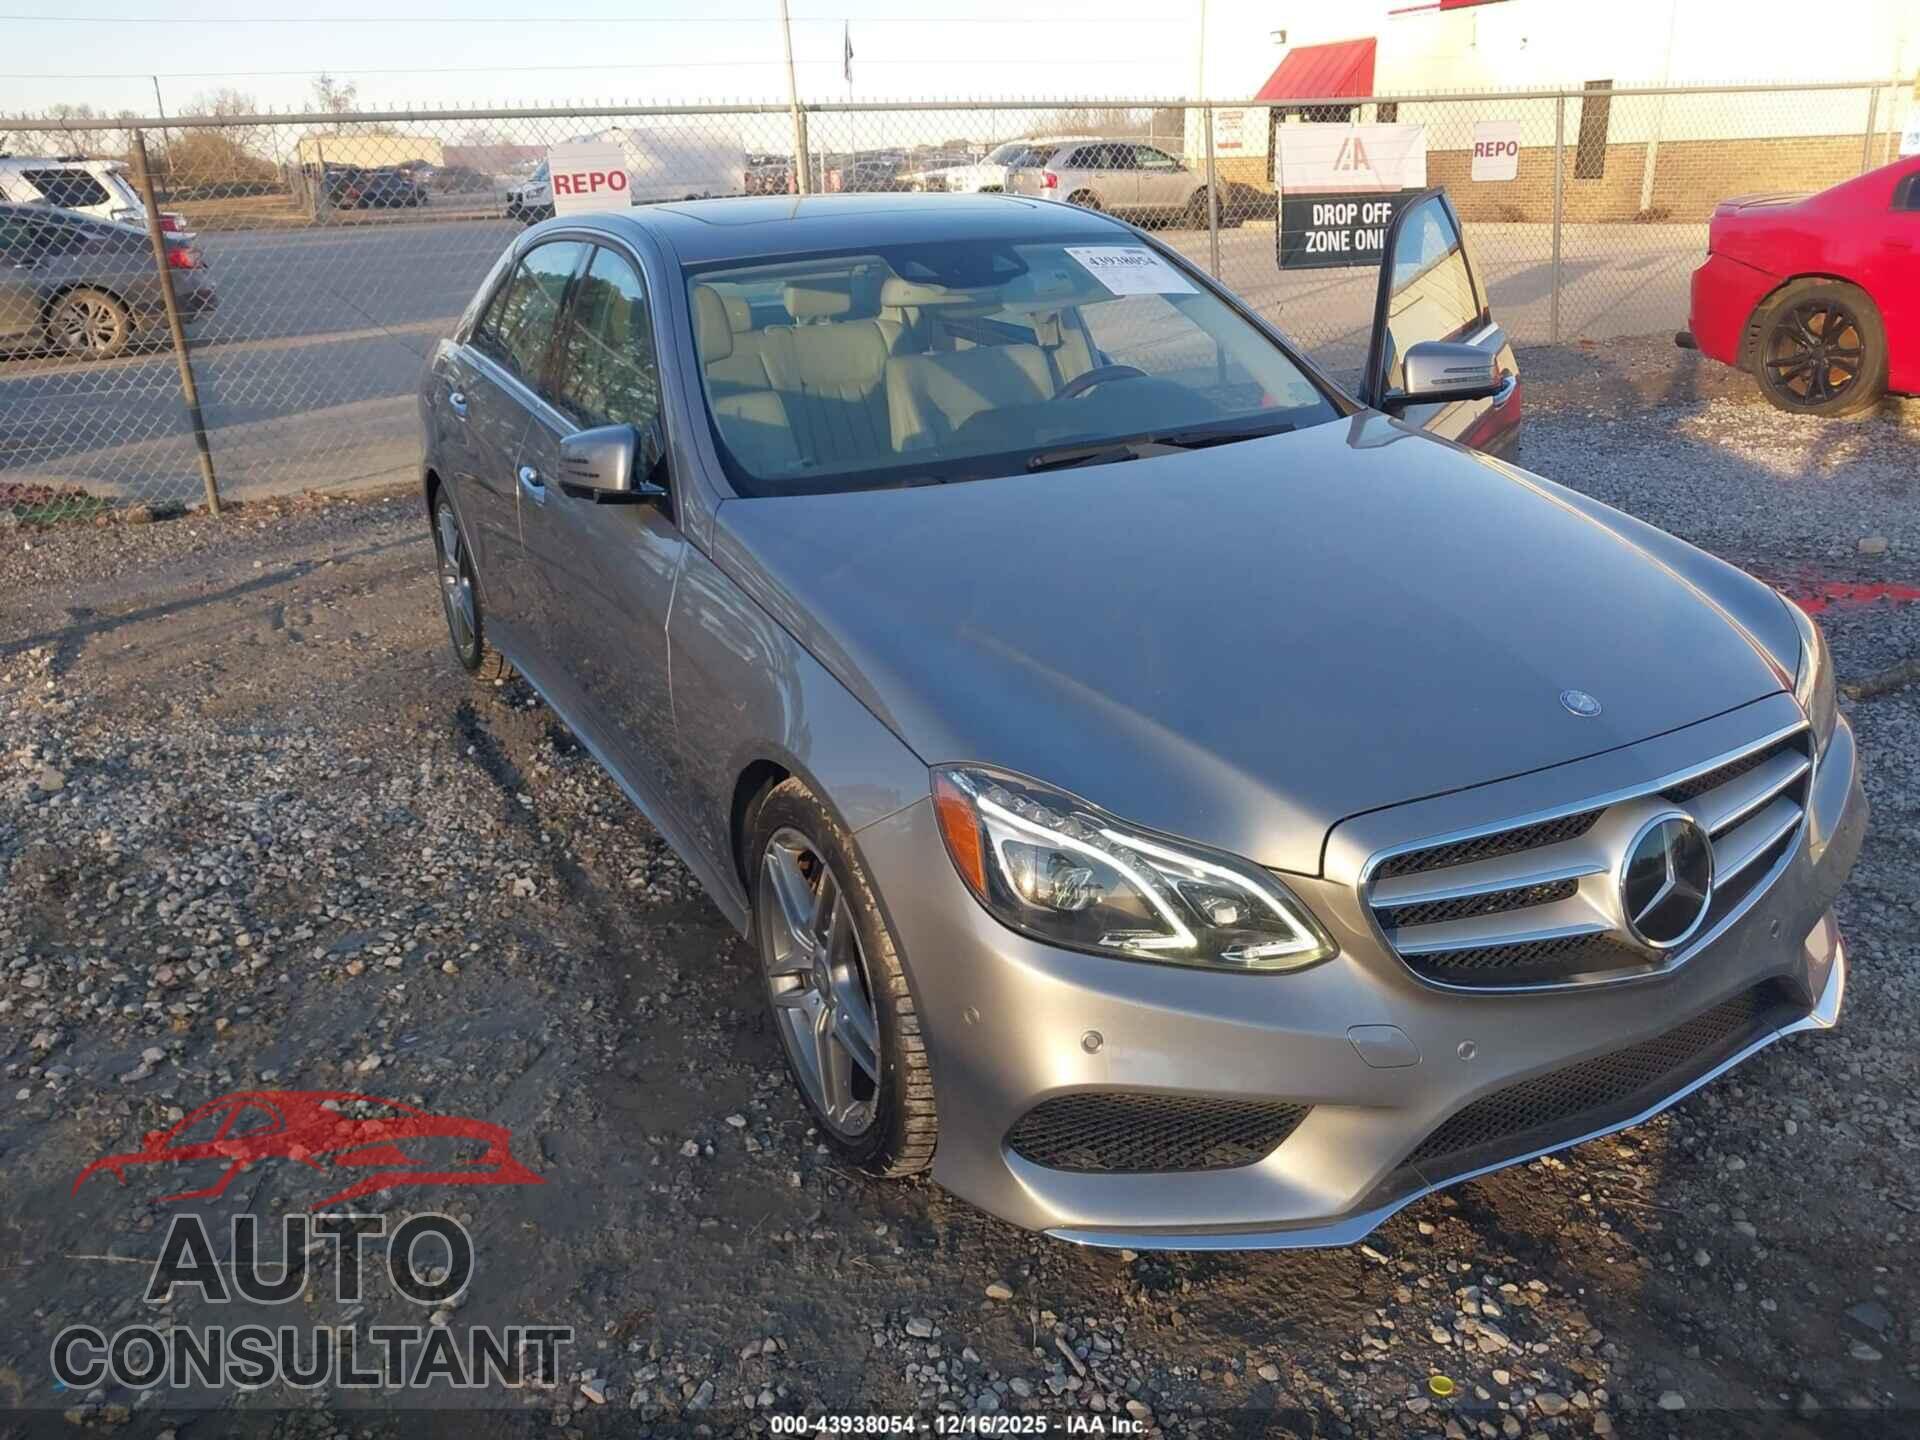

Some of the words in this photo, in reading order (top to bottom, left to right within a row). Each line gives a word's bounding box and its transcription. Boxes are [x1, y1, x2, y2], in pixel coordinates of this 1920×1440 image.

[1474, 141, 1518, 157] REPO
[553, 170, 626, 195] REPO
[1312, 203, 1358, 226] DROP
[1362, 202, 1392, 224] OFF
[1305, 230, 1351, 253] ZONE
[1355, 228, 1385, 251] ONL
